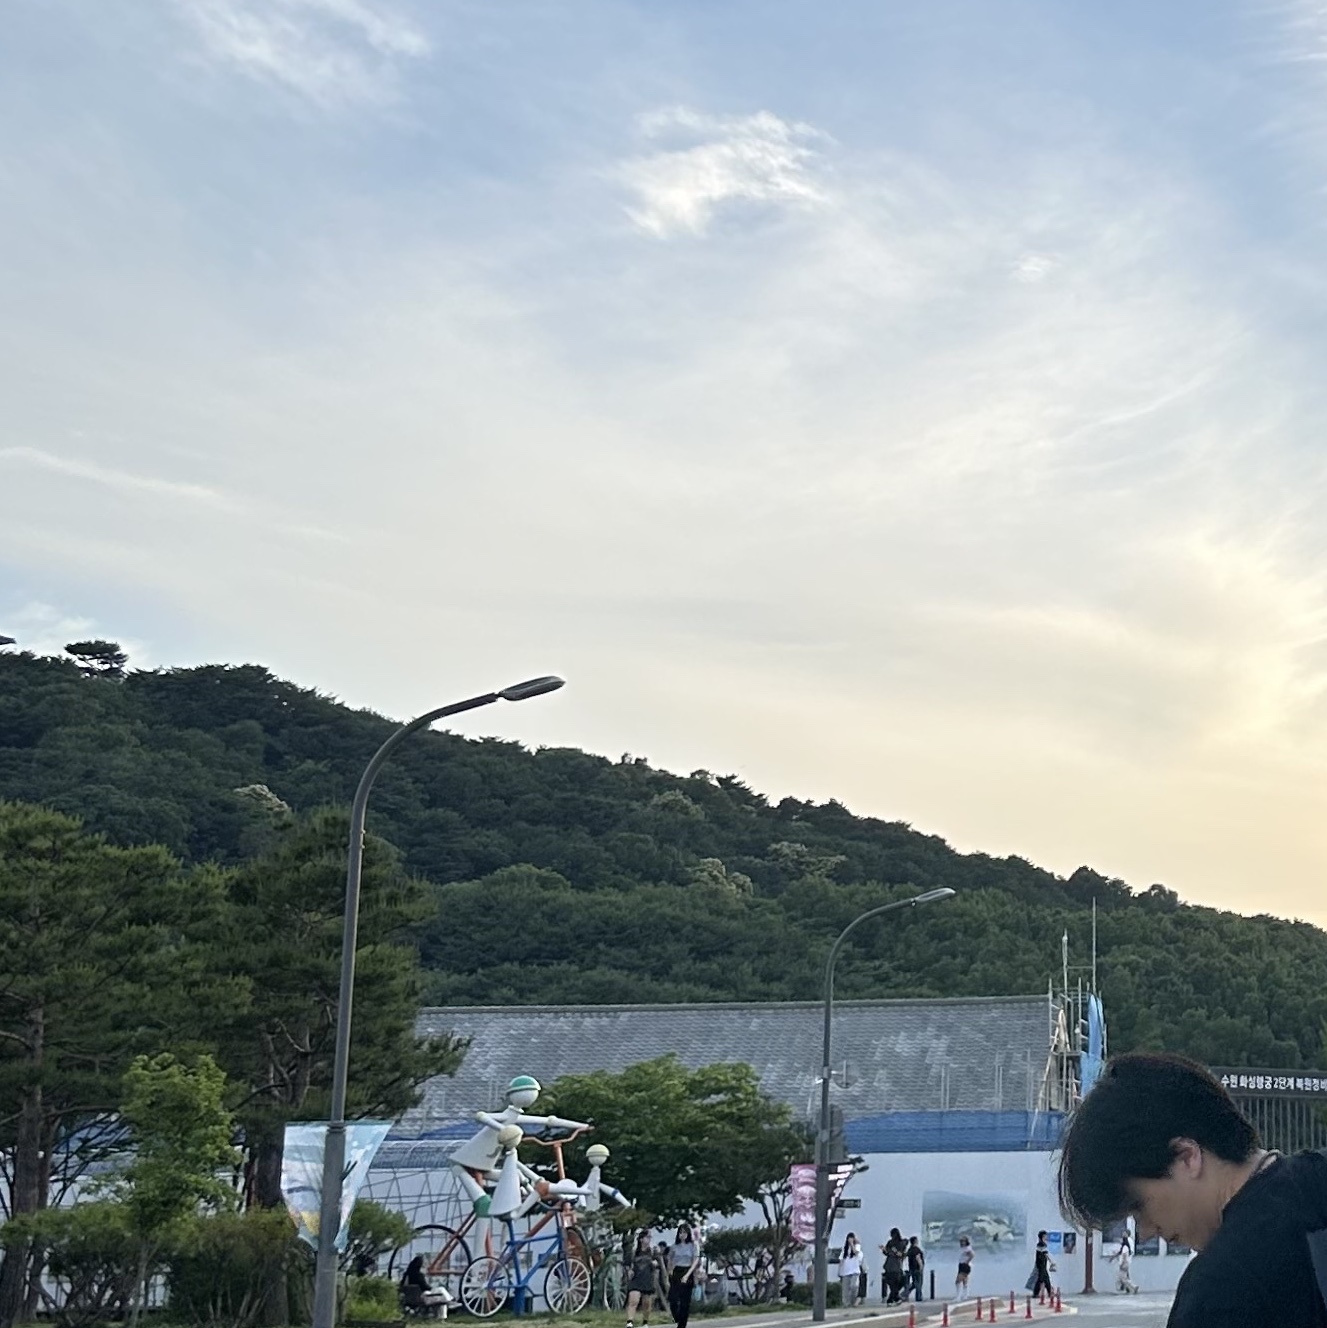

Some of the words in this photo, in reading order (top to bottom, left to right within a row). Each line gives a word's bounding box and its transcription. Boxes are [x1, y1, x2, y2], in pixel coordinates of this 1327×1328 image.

[1221, 1074, 1238, 1088] 수원
[1240, 1075, 1272, 1089] 화성행궁
[1273, 1077, 1294, 1089] 2단계
